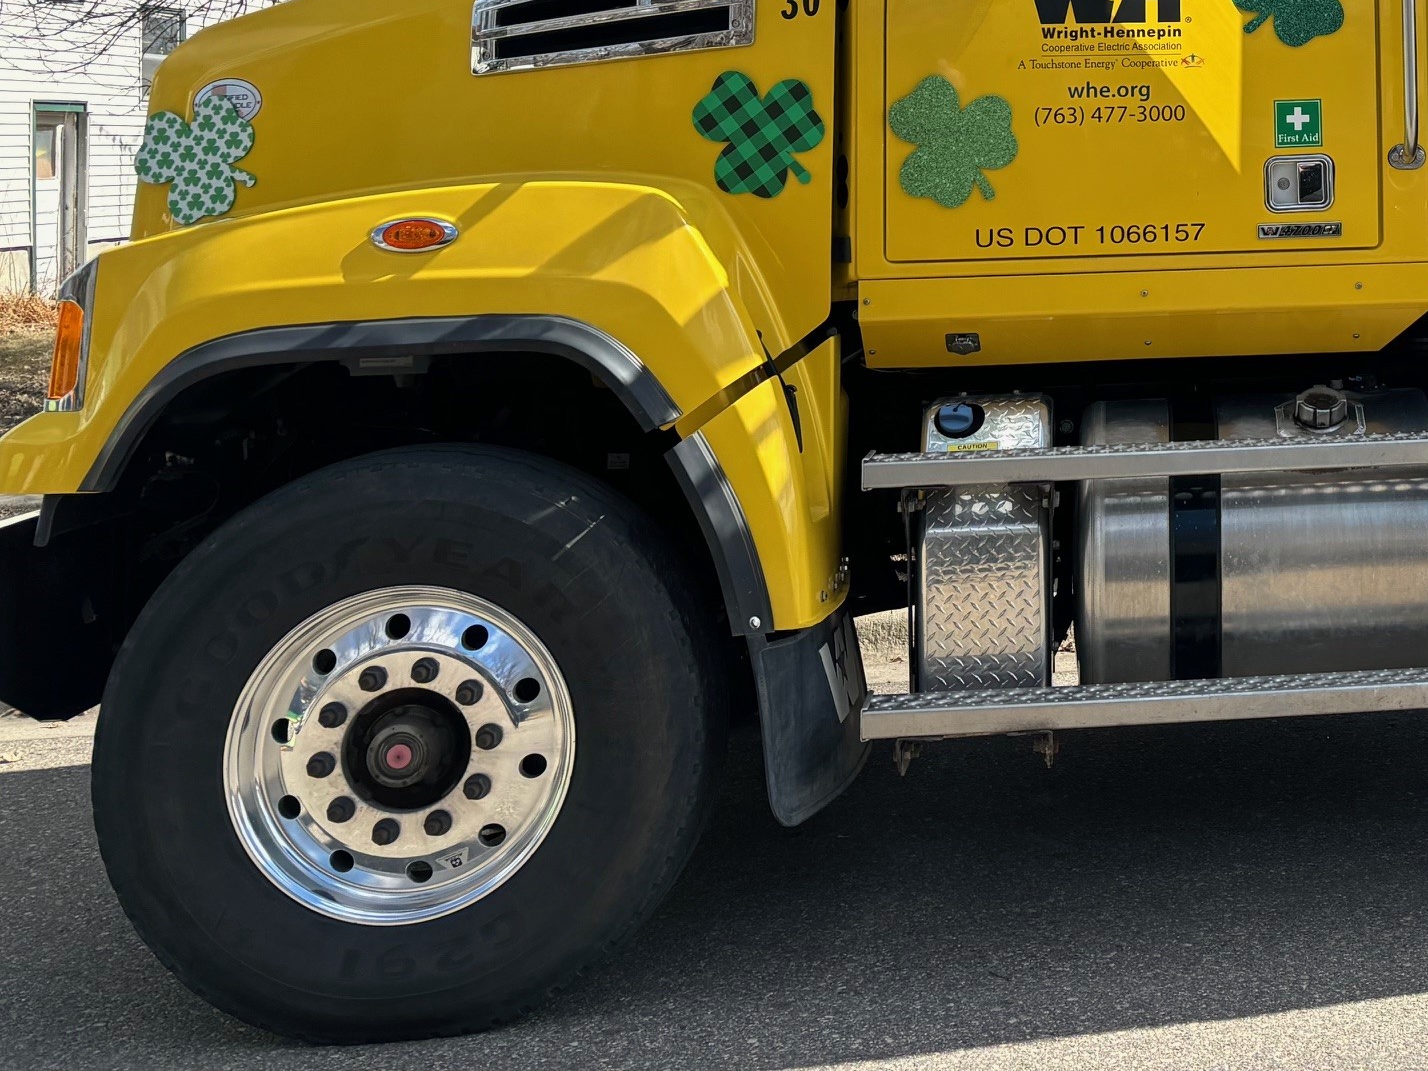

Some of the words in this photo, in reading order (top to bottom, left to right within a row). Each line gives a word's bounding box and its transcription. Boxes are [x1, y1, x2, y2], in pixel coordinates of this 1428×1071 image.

[1041, 25, 1182, 41] Wright-Hennepin
[1041, 44, 1095, 53] Cooperative
[1098, 42, 1130, 51] Electric
[1132, 42, 1182, 51] Association
[1017, 60, 1026, 69] A
[1029, 59, 1081, 69] Touchstone
[1121, 58, 1178, 69] Cooperative
[1067, 82, 1151, 101] whe.org
[1034, 106, 1084, 127] (763)
[1091, 105, 1186, 124] 477-3000
[1278, 133, 1299, 143] First
[1302, 133, 1319, 142] Aid
[976, 227, 1014, 247] US
[1025, 226, 1085, 246] DOT
[1096, 223, 1206, 244] 1066157
